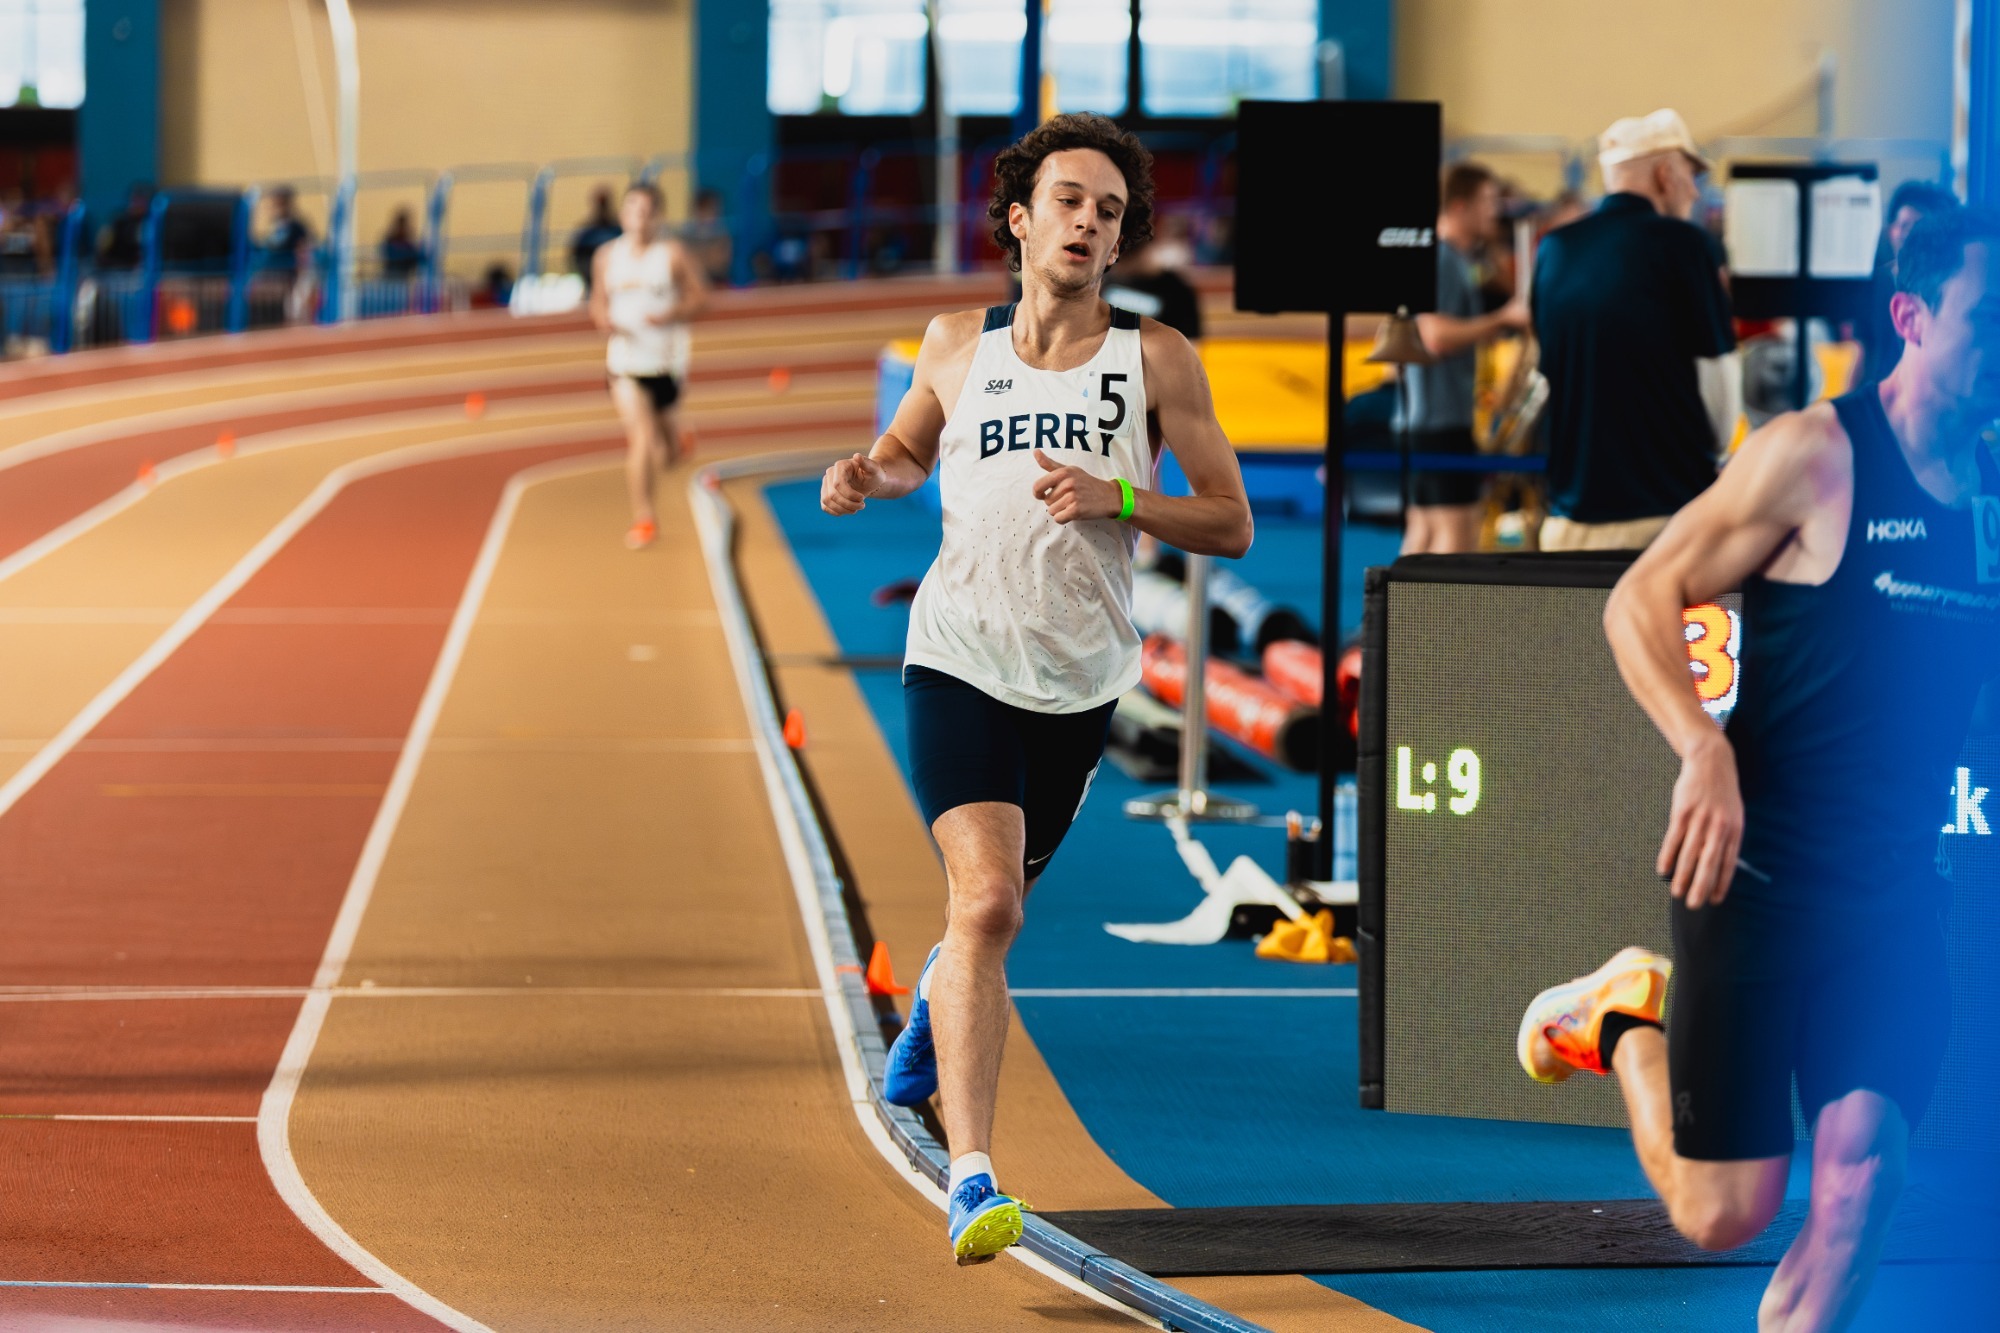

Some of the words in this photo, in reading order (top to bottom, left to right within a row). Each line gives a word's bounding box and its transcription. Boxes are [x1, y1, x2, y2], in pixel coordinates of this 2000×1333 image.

[984, 378, 1013, 391] SAA
[1098, 373, 1127, 431] 5
[979, 412, 1114, 461] BERRY
[1867, 518, 1927, 542] HOKA
[1941, 766, 1991, 834] k
